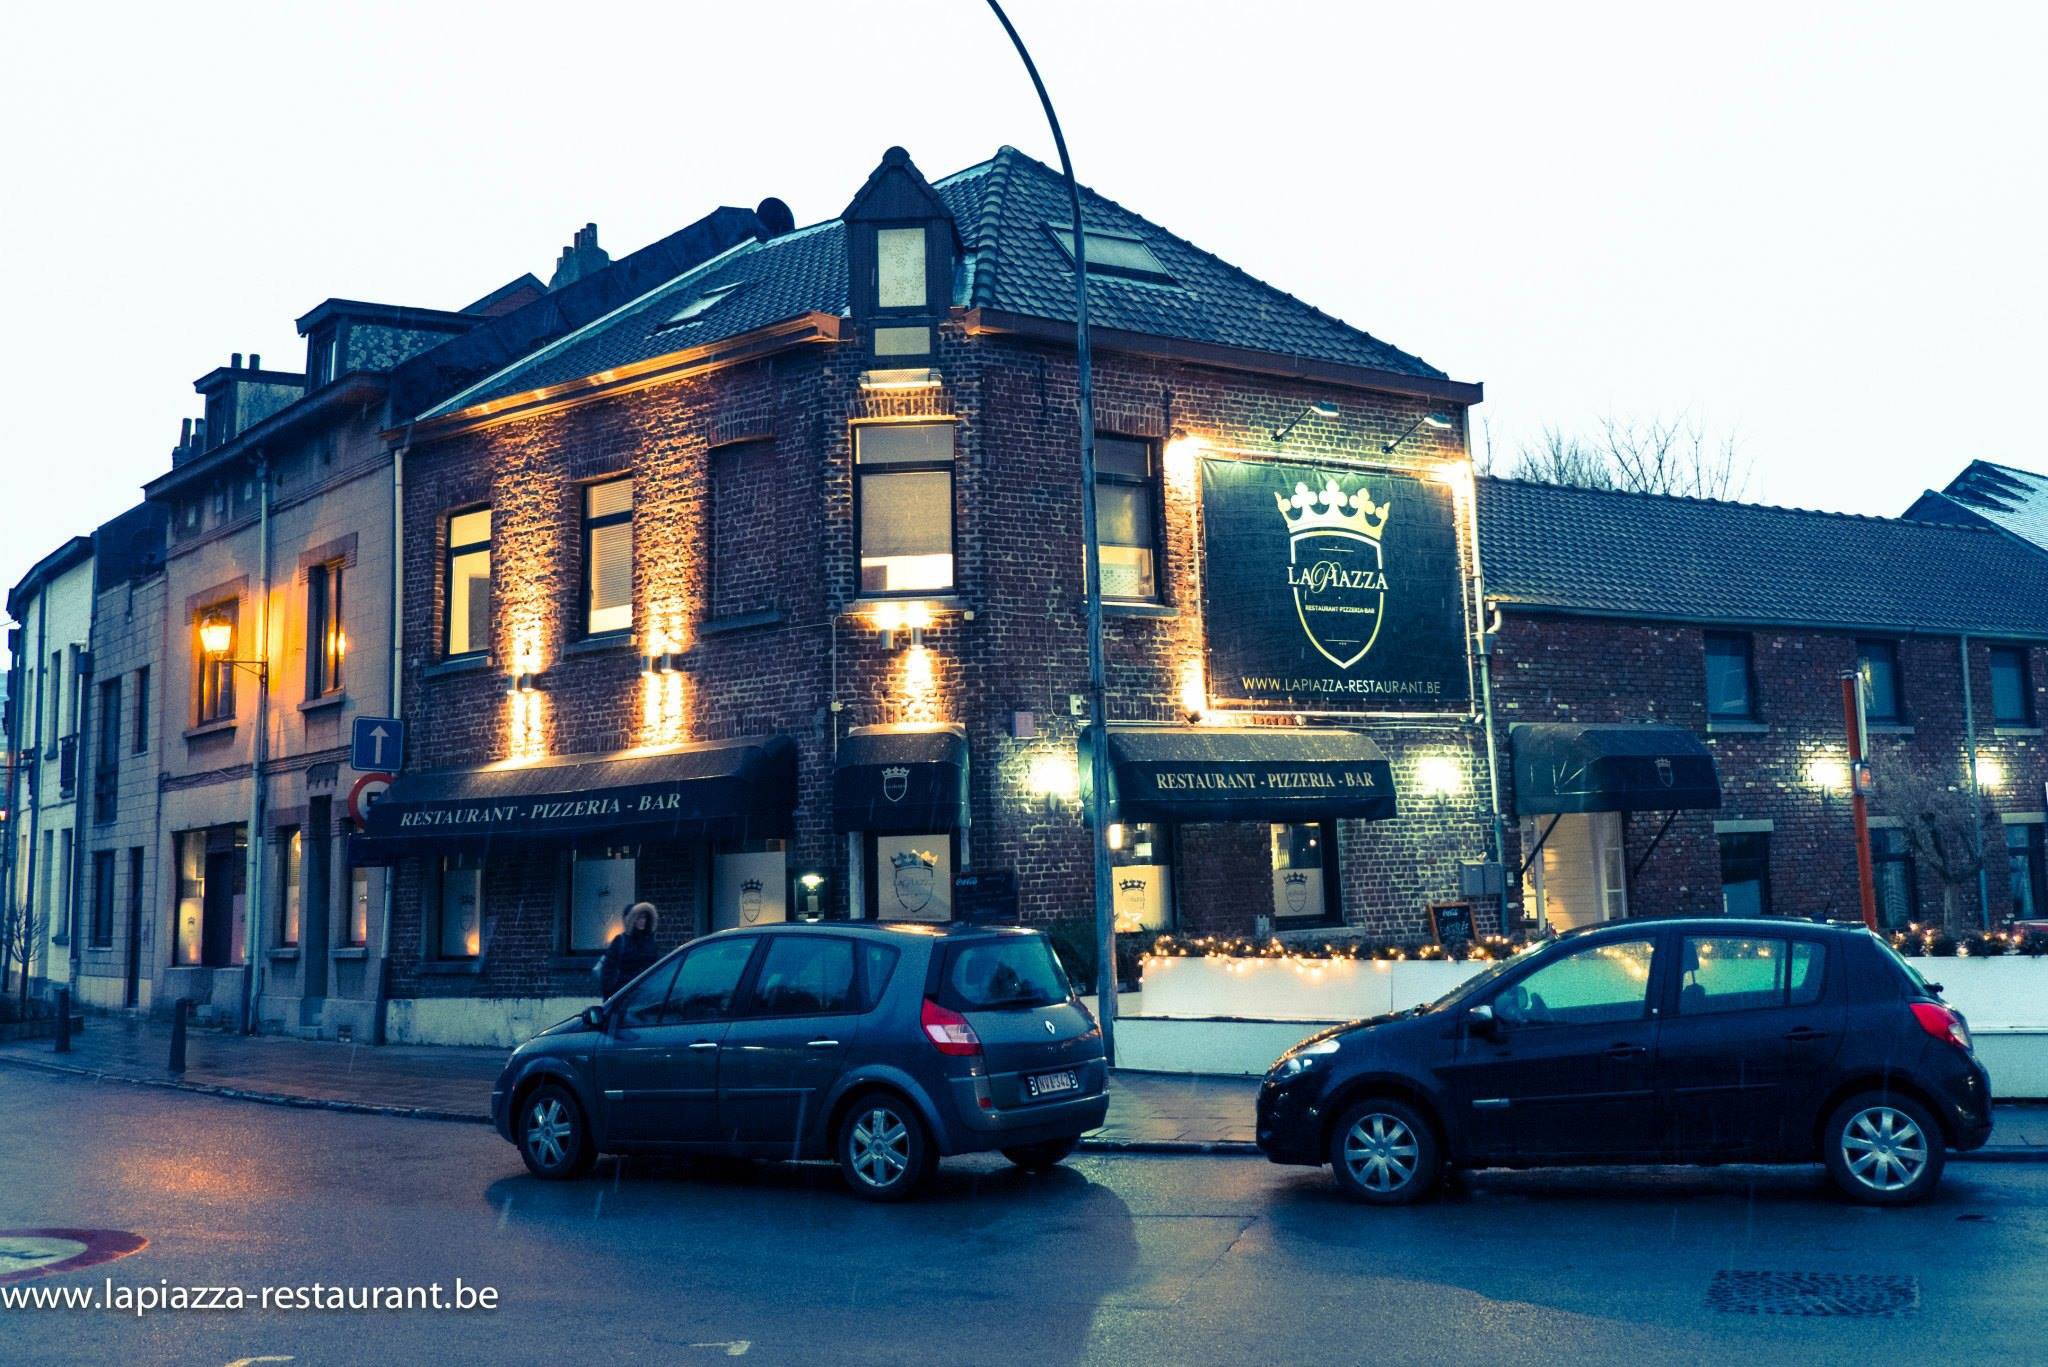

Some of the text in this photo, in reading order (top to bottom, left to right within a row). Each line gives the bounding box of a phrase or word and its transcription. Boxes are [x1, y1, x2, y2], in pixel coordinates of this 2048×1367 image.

[1242, 676, 1440, 695] WWW.LAPIAZZA-RESTAURANT.BE
[1156, 773, 1256, 789] RESTAURANT
[1267, 772, 1336, 788] PIZZERIA
[1346, 772, 1375, 788] BAR
[400, 805, 517, 827] RESTAURANT
[530, 798, 620, 819] PIZZERIA
[638, 792, 681, 812] BAR
